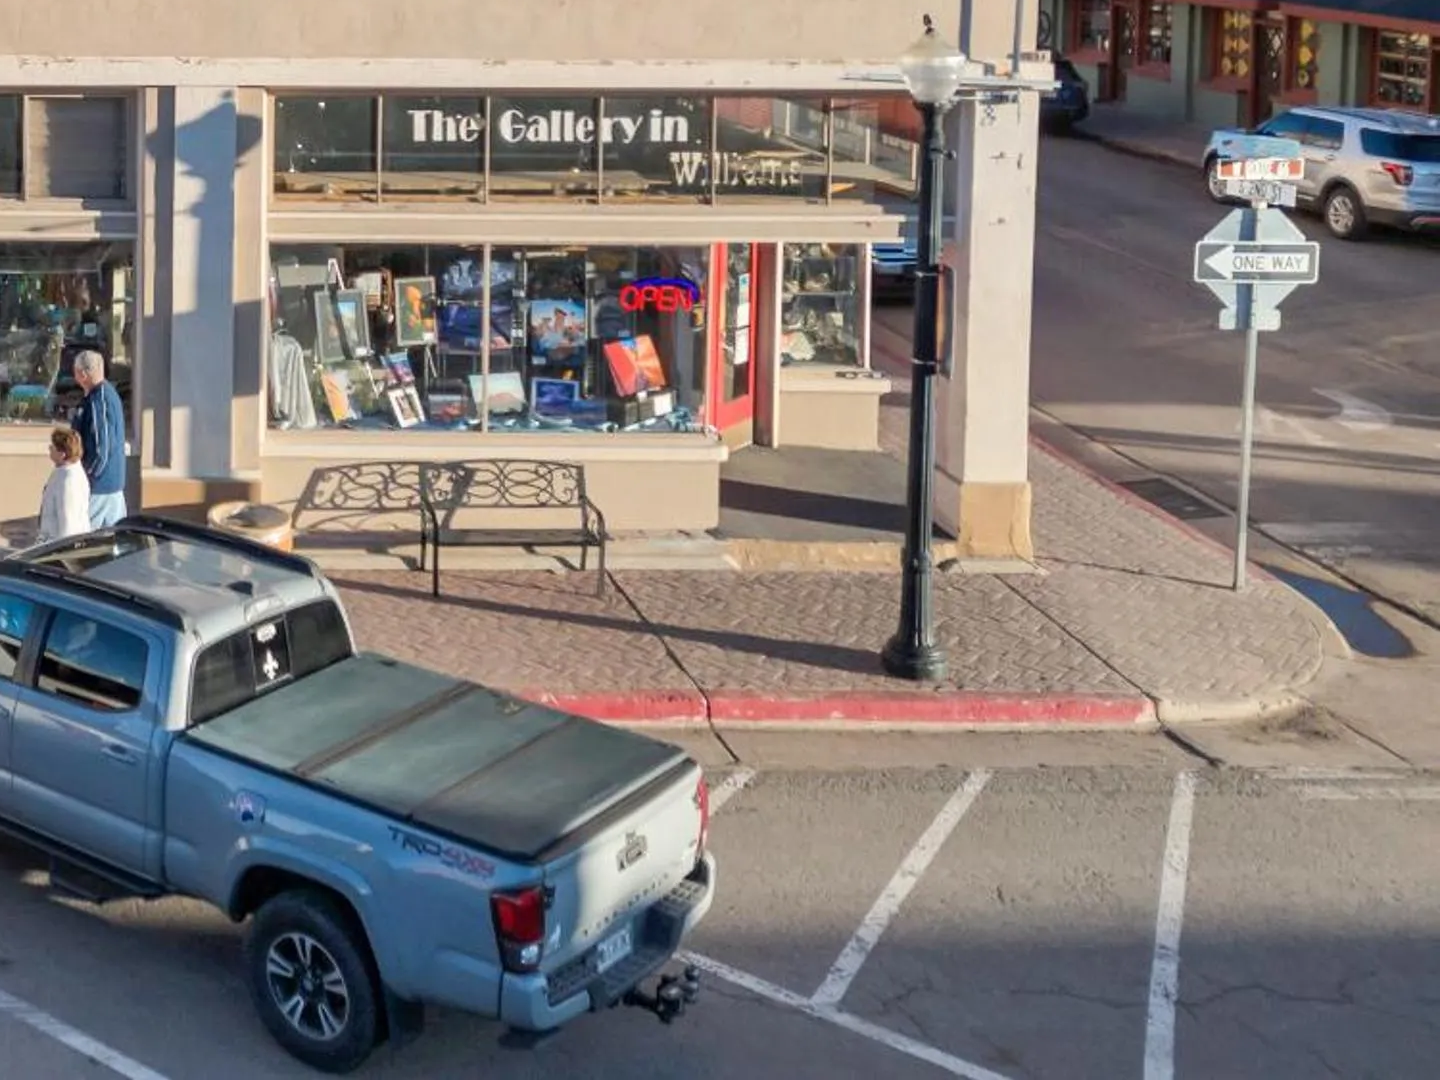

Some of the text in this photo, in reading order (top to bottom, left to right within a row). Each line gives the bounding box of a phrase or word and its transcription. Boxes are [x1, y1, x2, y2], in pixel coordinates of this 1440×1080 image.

[407, 108, 688, 145] The Gallery in
[669, 151, 803, 187] Williams
[1232, 255, 1304, 270] ONE WAY
[619, 285, 693, 312] OPEN
